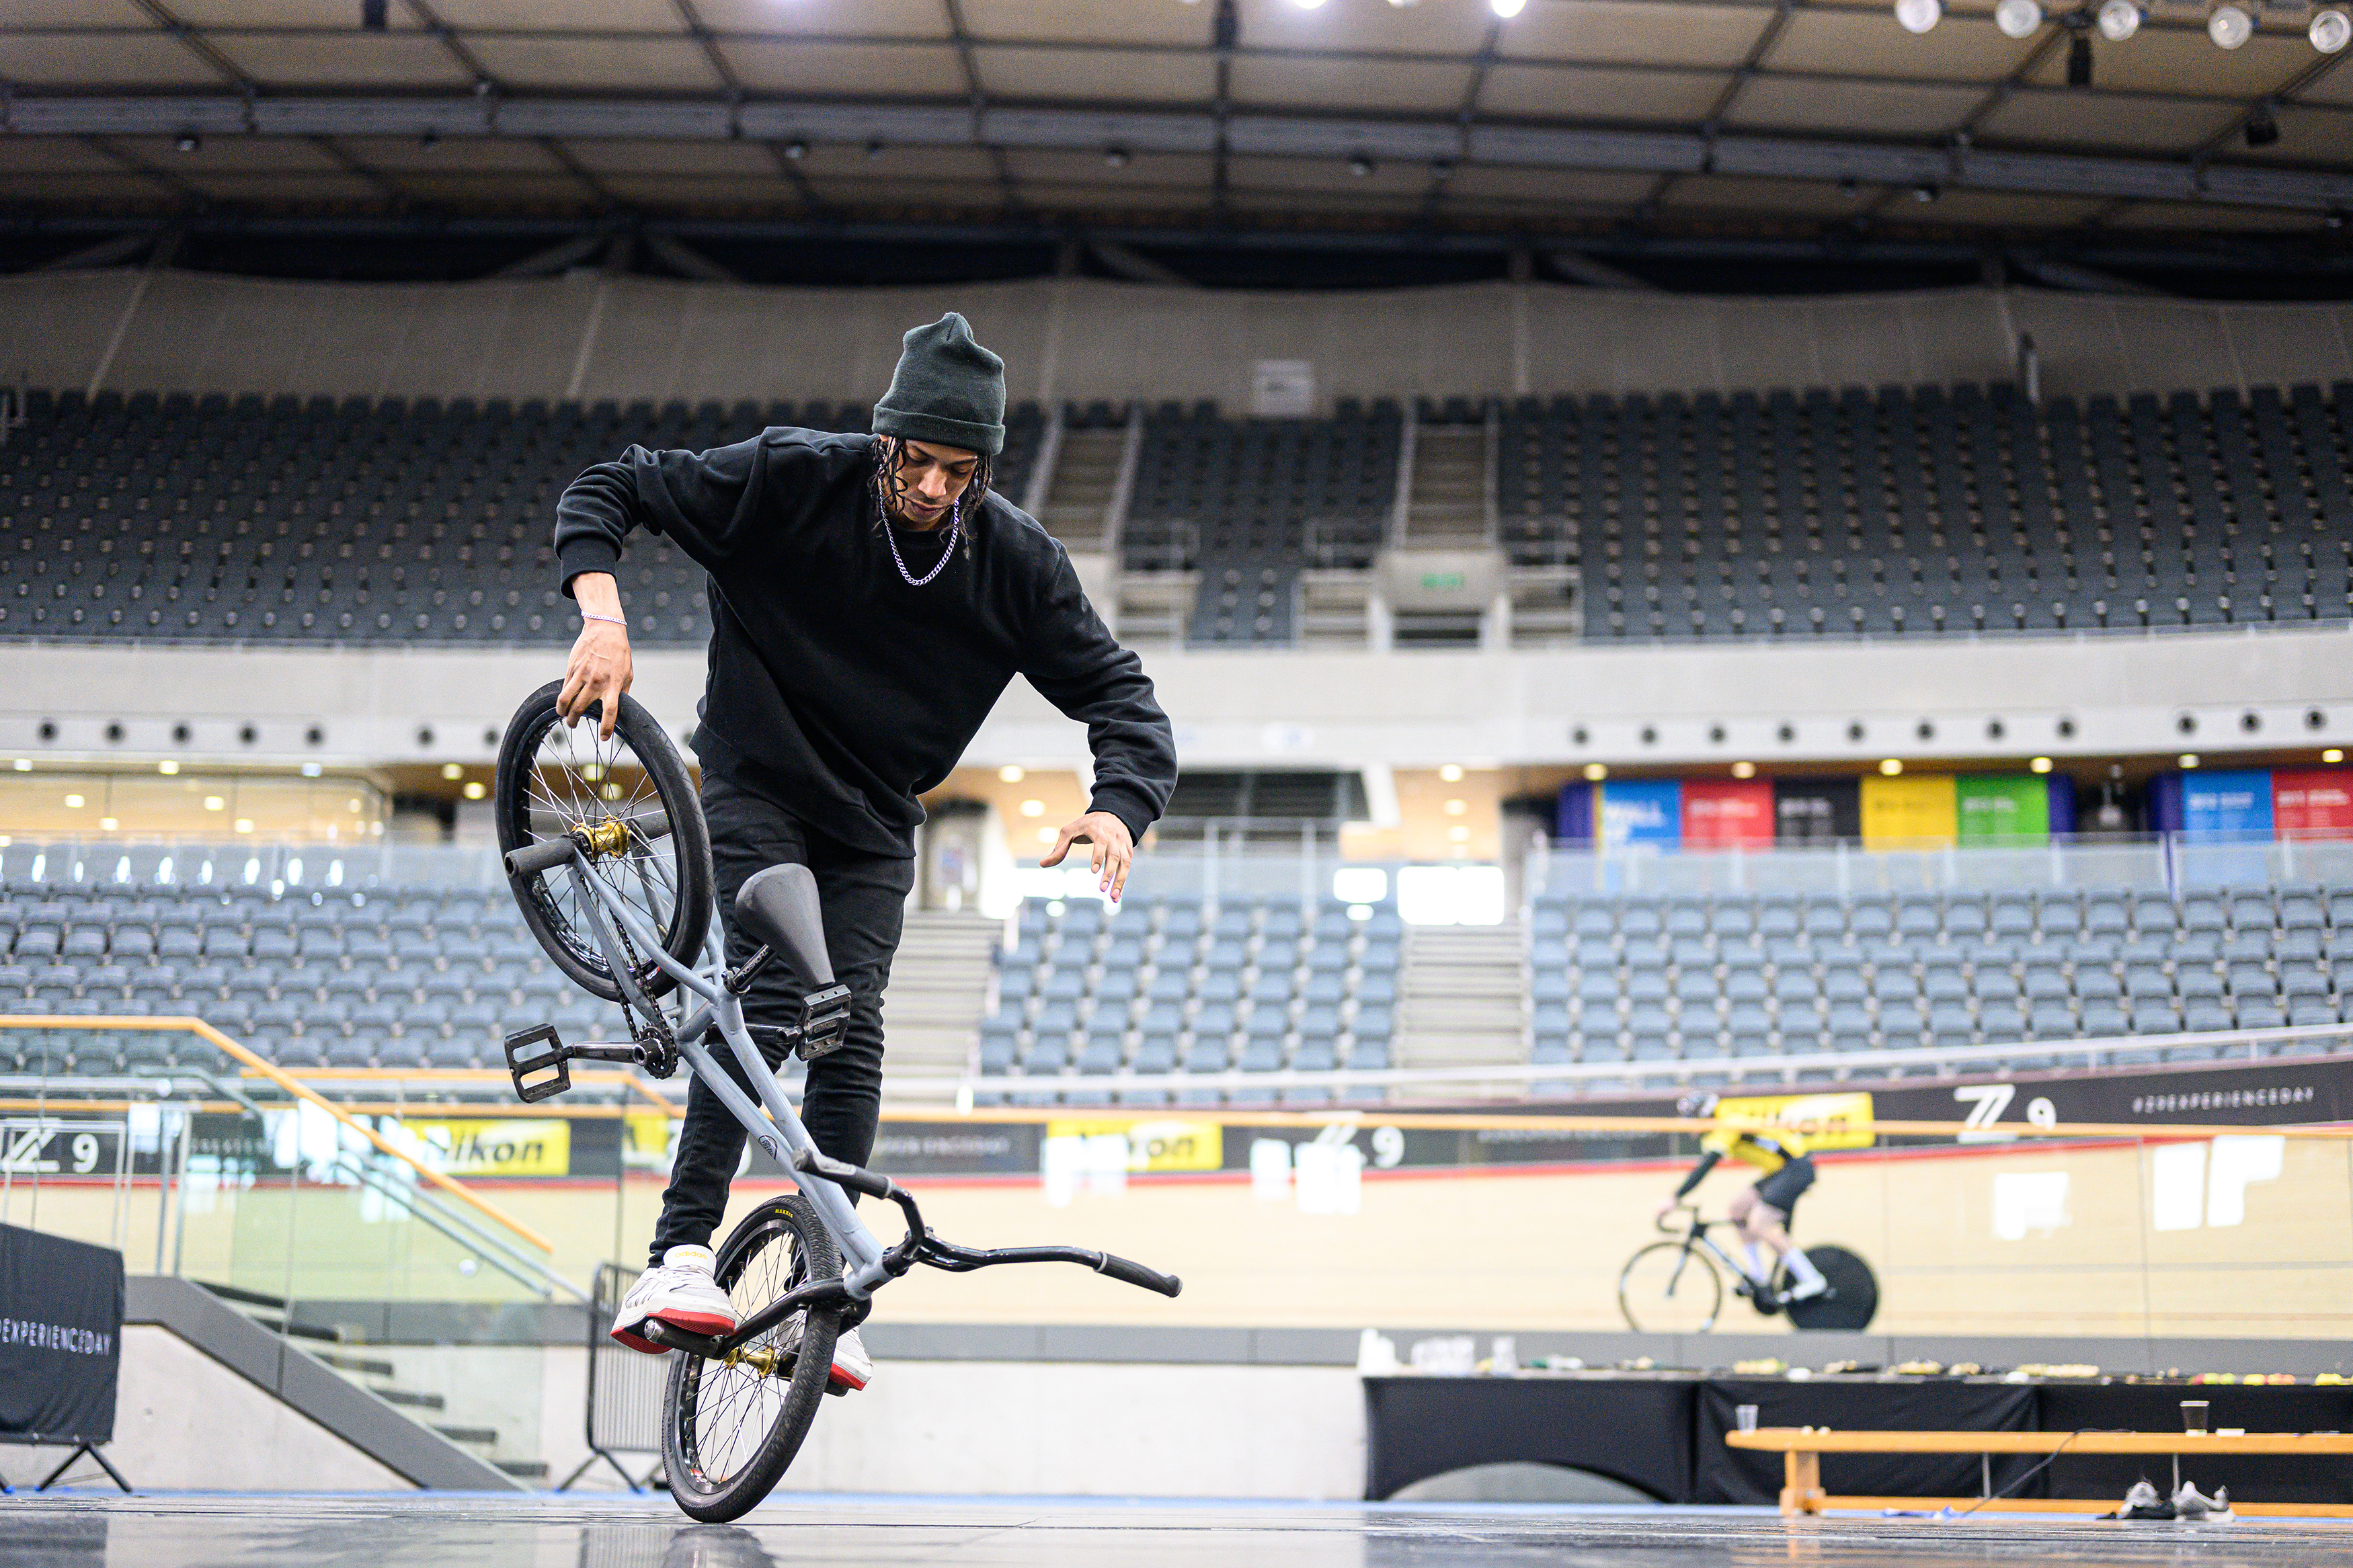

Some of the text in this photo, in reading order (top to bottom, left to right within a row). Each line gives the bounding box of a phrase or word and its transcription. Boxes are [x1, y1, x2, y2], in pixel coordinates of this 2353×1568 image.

[72, 1132, 99, 1173] 9
[1371, 1126, 1404, 1169] 9
[774, 1208, 793, 1219] MAXXIS
[674, 1250, 707, 1260] adidas
